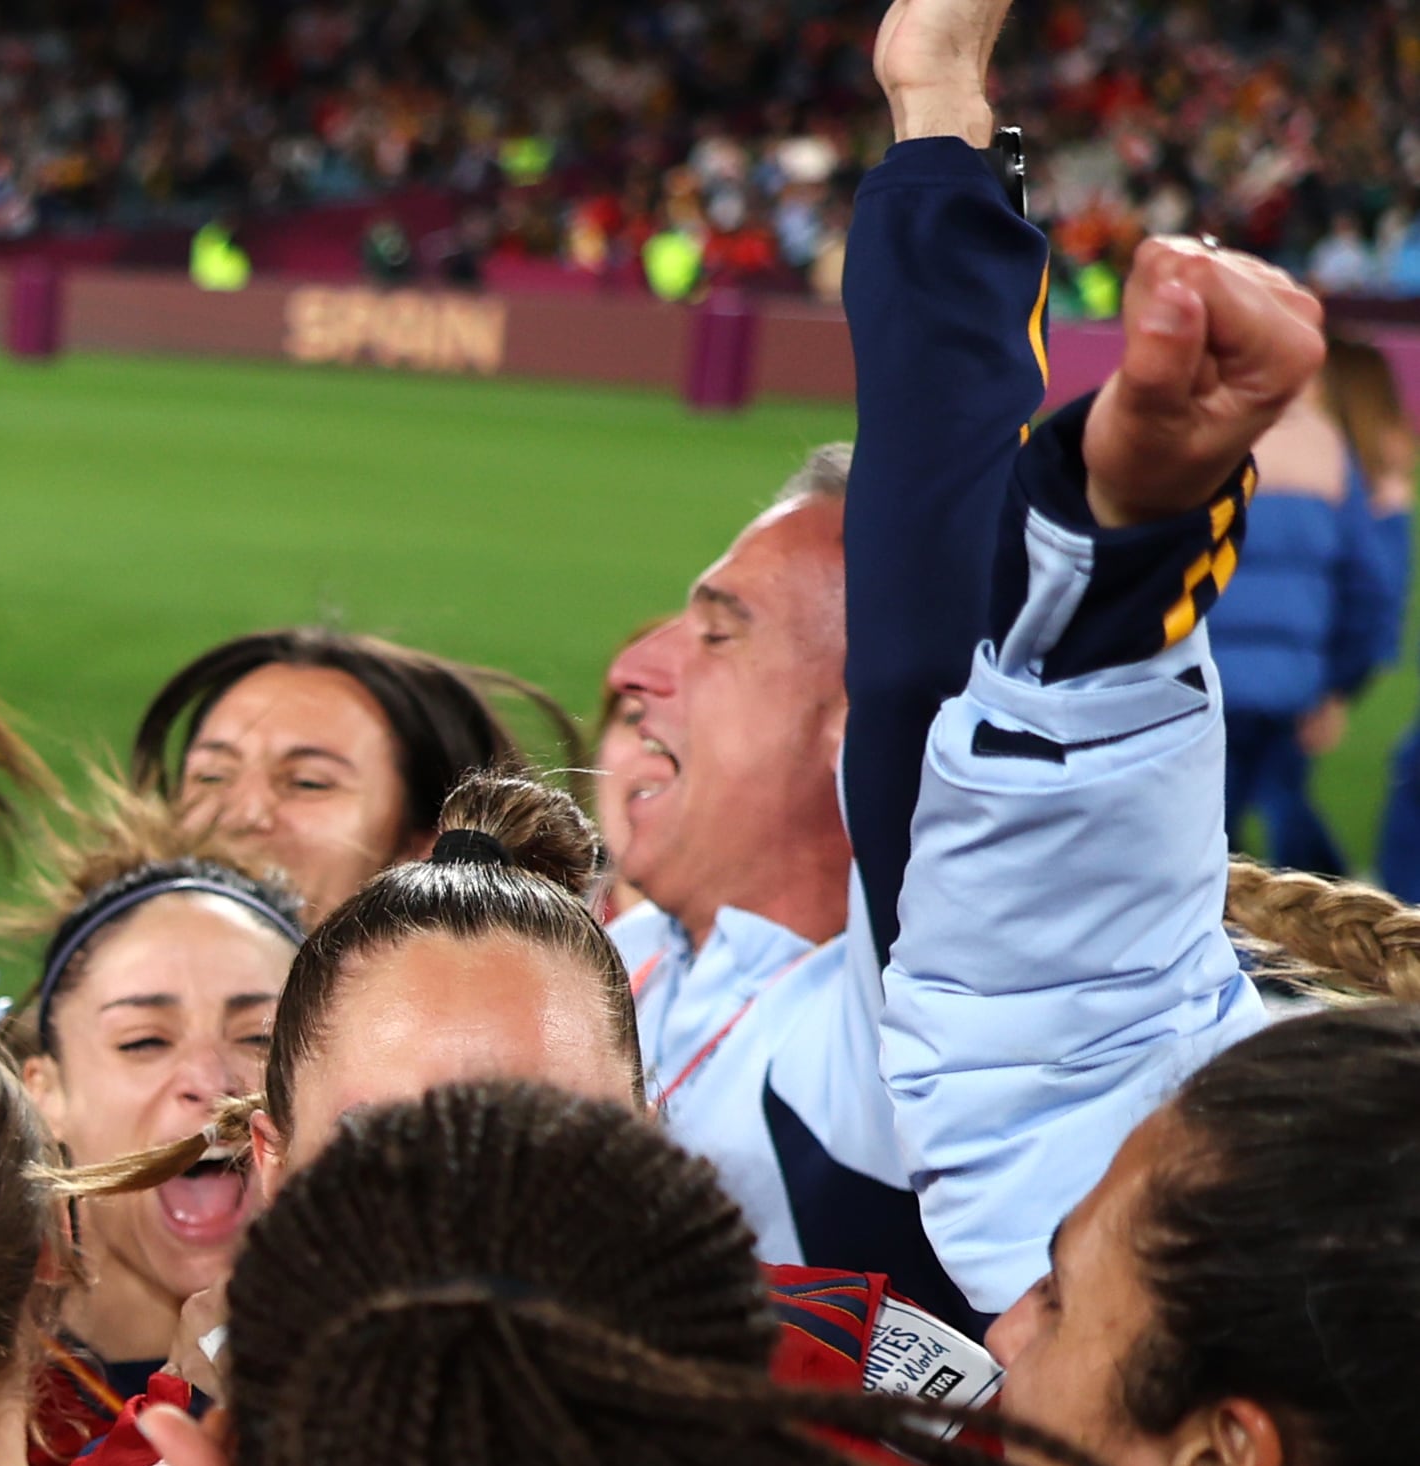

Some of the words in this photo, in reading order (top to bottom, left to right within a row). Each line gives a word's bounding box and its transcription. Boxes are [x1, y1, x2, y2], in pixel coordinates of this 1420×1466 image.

[285, 286, 505, 376] SPAIN
[896, 1336, 951, 1382] World
[924, 1372, 958, 1399] FIFA
